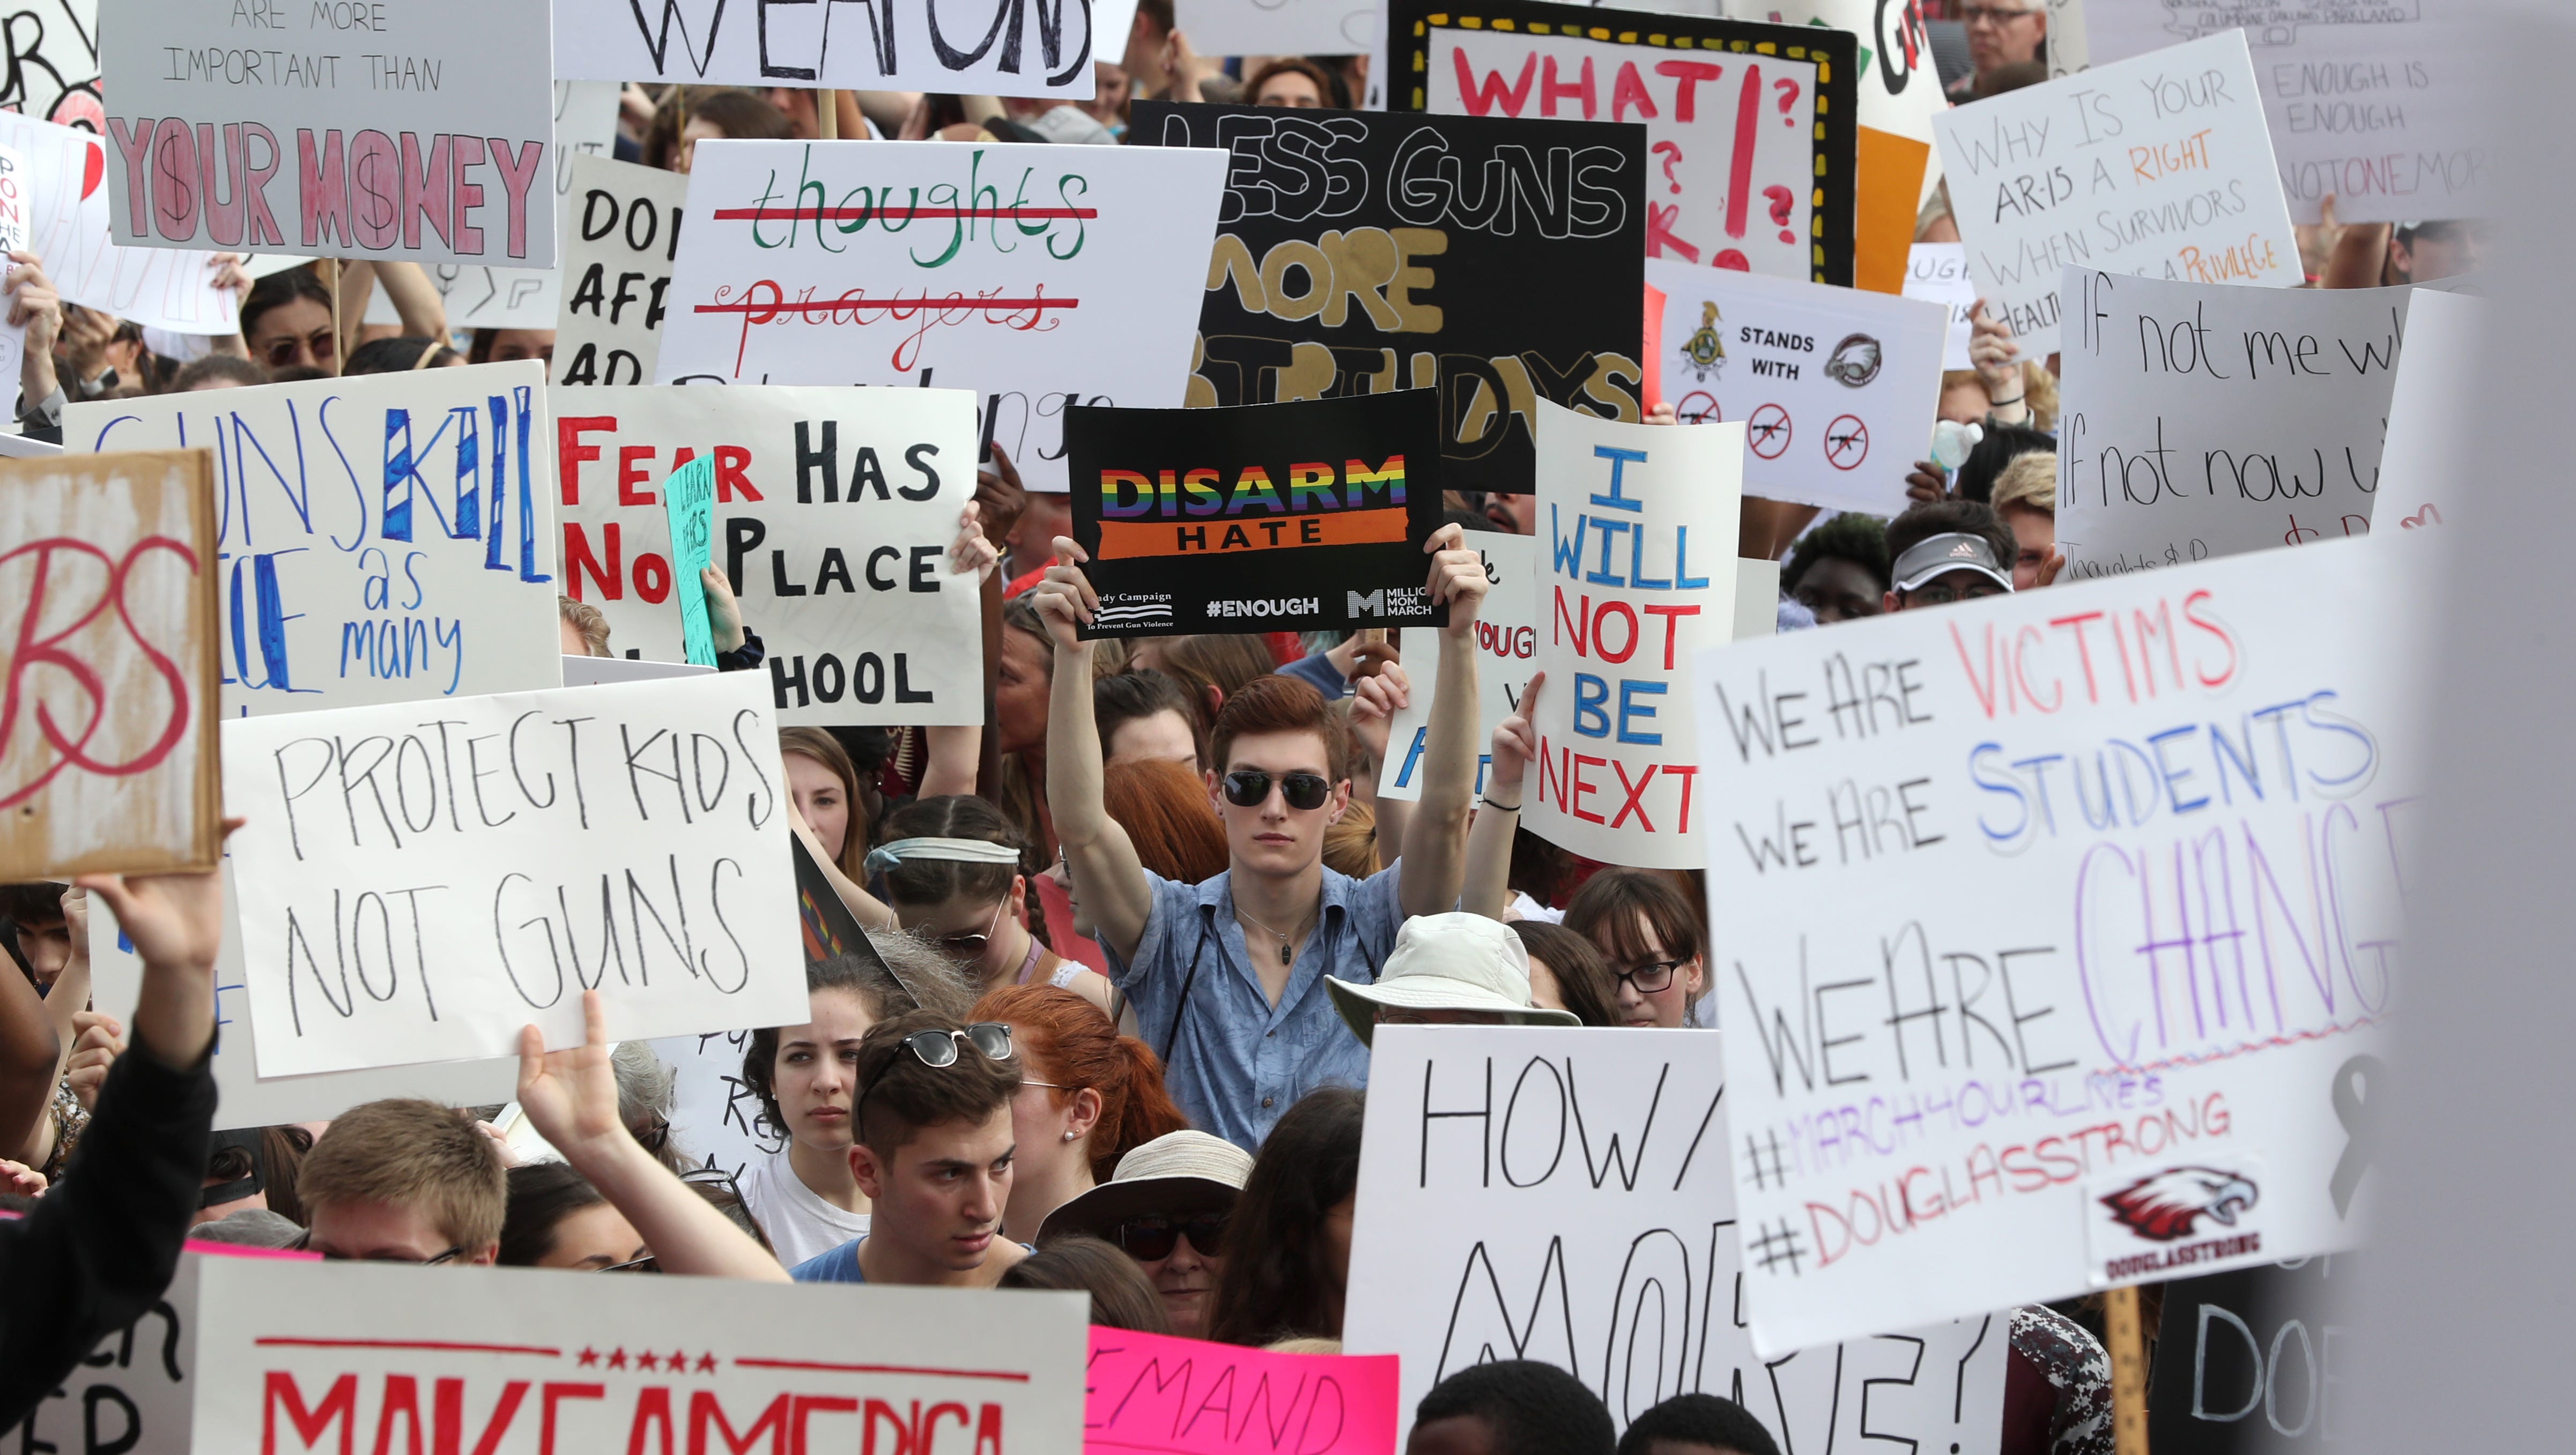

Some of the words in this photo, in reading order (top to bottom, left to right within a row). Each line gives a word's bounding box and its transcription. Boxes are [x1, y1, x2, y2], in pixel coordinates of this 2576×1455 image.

[232, 0, 285, 30] ARE
[310, 2, 387, 32] MORE
[163, 47, 341, 88] IMPORTANT
[361, 55, 441, 91] THAN
[1453, 46, 1722, 123] WHAT
[2273, 61, 2389, 99] ENOUGH
[2404, 60, 2430, 90] IS
[1950, 114, 2050, 177] WHY
[2068, 88, 2123, 151] IS
[2140, 68, 2238, 121] YOUR
[2289, 104, 2407, 135] ENOUGH
[1387, 126, 1626, 239] GUNS
[2091, 156, 2116, 195] A
[2128, 128, 2212, 188] RIGHT
[752, 143, 1089, 268] thoughts
[1981, 230, 2091, 288] WHEN
[2102, 177, 2248, 254] SURVIVORS
[714, 279, 1060, 379] prayers
[1740, 326, 1815, 353] STANDS
[2138, 301, 2231, 380] not
[2244, 330, 2331, 380] me
[1752, 358, 1800, 381] WITH
[794, 420, 941, 504] HAS
[1100, 455, 1407, 517] DISARM
[1590, 444, 1648, 513] I
[2100, 416, 2189, 508] not
[2205, 447, 2325, 503] now
[726, 517, 944, 598] PLACE
[1177, 518, 1322, 551] HATE
[1551, 503, 1709, 590] WILL
[358, 547, 428, 610] as
[1097, 594, 1116, 604] ady
[1119, 592, 1172, 603] Campaign
[1206, 597, 1320, 618] #ENOUGH
[1387, 587, 1427, 598] MILLIO
[1387, 596, 1418, 607] MOM
[1388, 605, 1432, 617] MARCH
[340, 617, 462, 695] many
[1554, 585, 1701, 670] NOT
[769, 652, 934, 709] HOOL
[1573, 672, 1669, 746] BE
[1715, 669, 1820, 763] WE
[1824, 650, 1933, 741] ARE
[1948, 589, 2240, 721] VICTIMS
[275, 710, 595, 861] PROTECT
[620, 708, 774, 831] KIDS
[1538, 734, 1701, 834] NEXT
[1735, 800, 1819, 875] WE
[1832, 777, 1946, 867] ARE
[1968, 689, 2377, 852] STUDENTS
[286, 884, 448, 1037] NOT
[494, 853, 749, 1011] GUNS
[1735, 934, 1875, 1098] WE
[1881, 919, 2079, 1080] ARE
[1420, 1056, 1669, 1192] HOW
[1748, 1092, 2232, 1276] #DOUGLASSTRONG
[1084, 1348, 1345, 1455] EMAND
